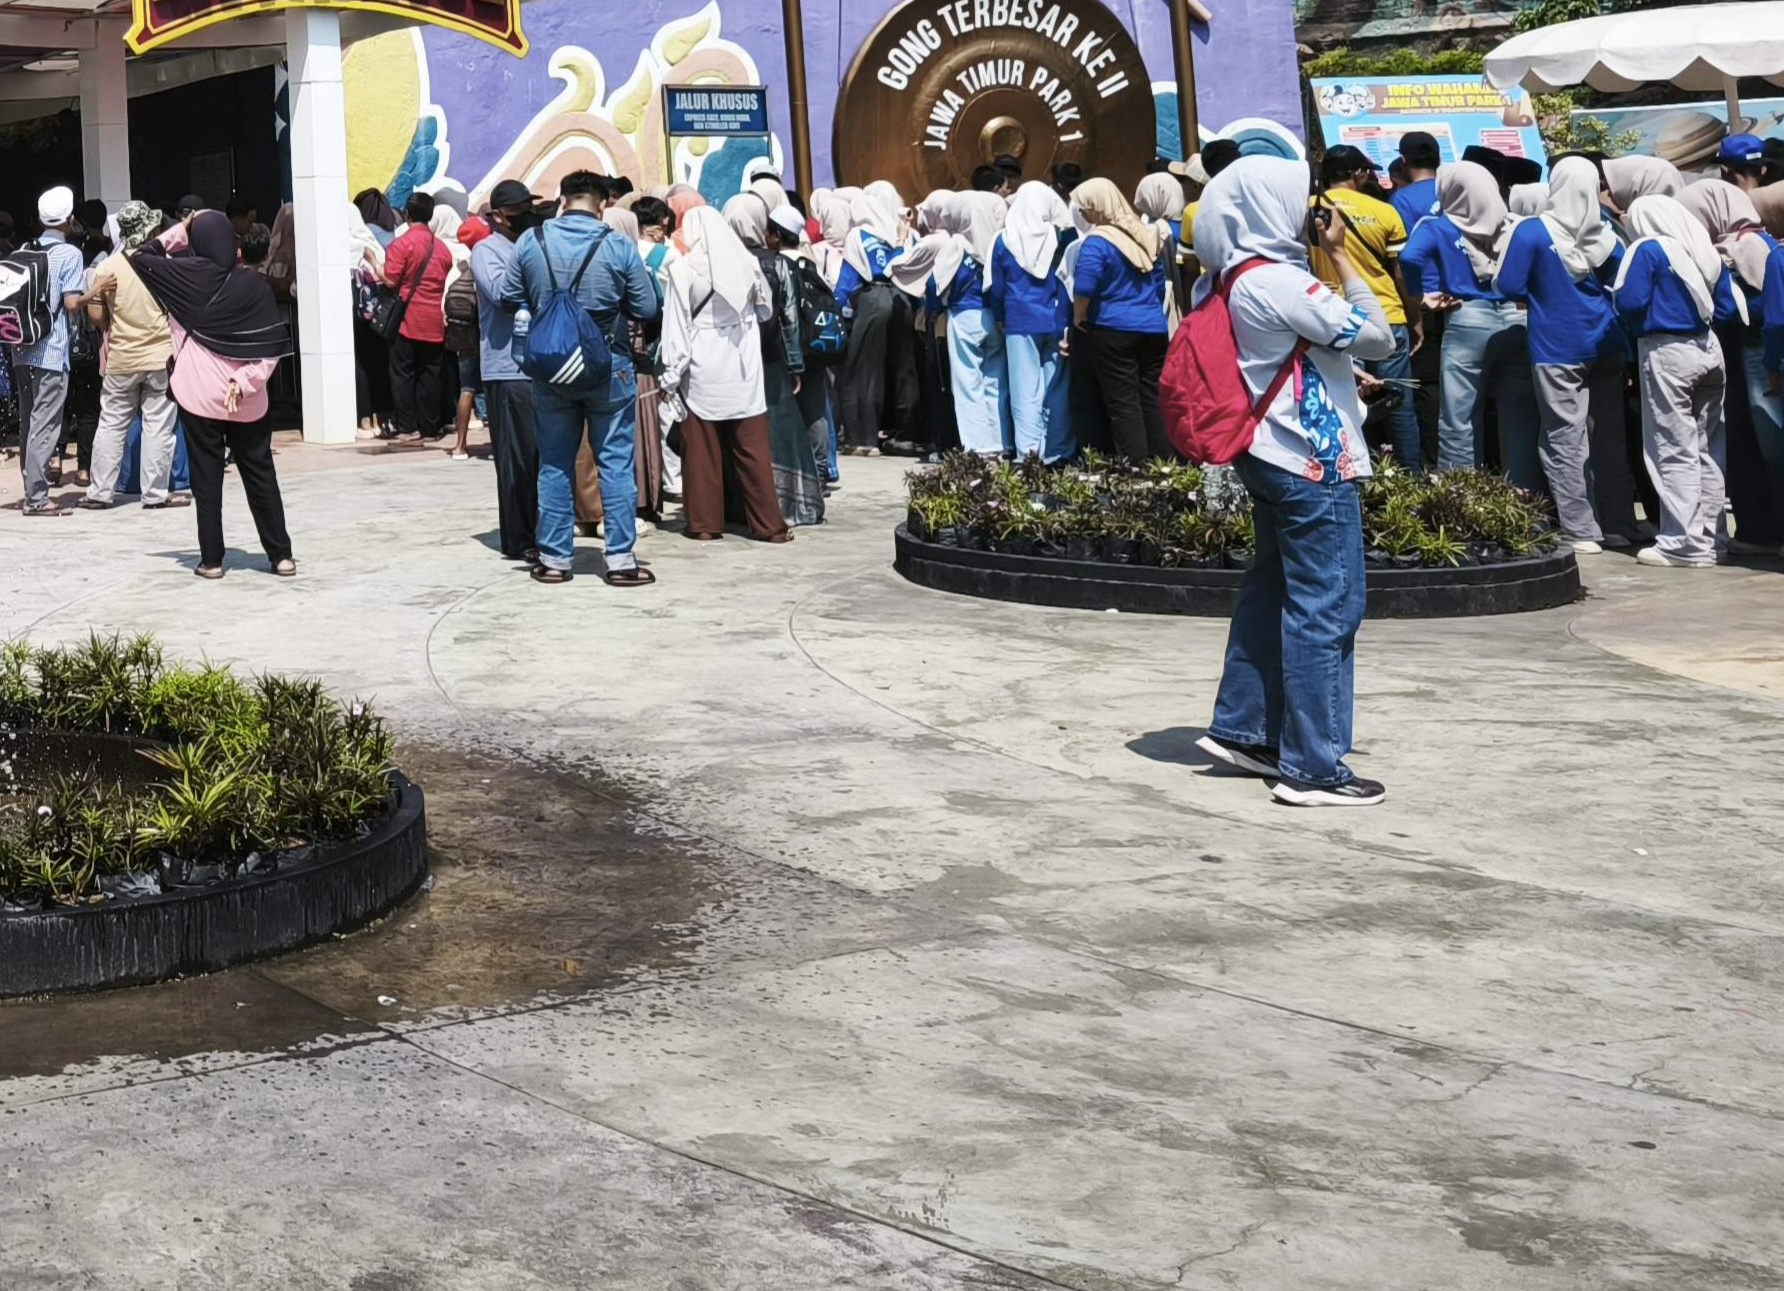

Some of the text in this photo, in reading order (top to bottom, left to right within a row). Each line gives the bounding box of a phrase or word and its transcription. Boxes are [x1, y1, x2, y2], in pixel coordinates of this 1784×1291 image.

[877, 18, 942, 91] GONG
[1072, 30, 1116, 78] KE
[1096, 70, 1129, 99] II
[1387, 83, 1424, 96] INFO
[675, 93, 758, 110] JALUR KHUSUS
[924, 59, 1084, 150] JAWA TIMUR PARK 1
[1381, 96, 1420, 108] JAWA
[1421, 96, 1465, 108] TIMUR
[1466, 94, 1503, 107] PARK
